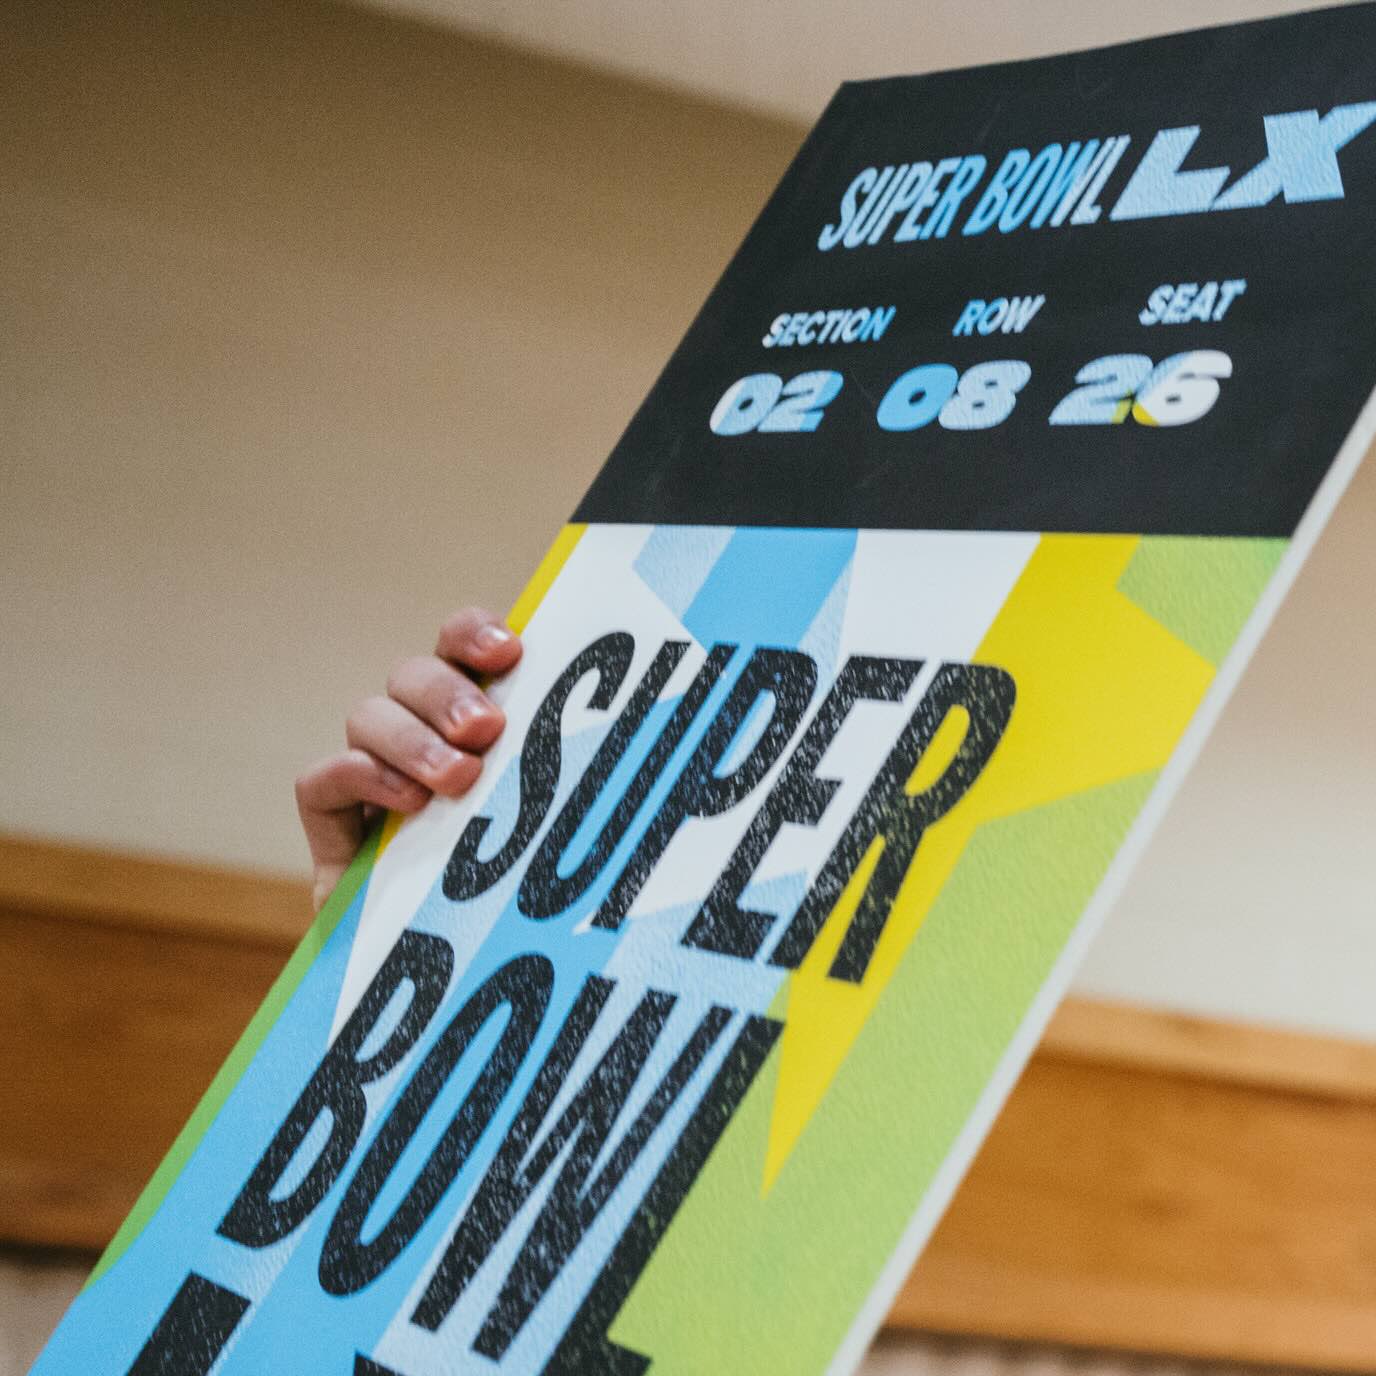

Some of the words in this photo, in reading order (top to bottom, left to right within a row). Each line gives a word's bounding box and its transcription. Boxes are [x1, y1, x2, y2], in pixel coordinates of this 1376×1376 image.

[817, 153, 986, 251] SUPER
[962, 134, 1131, 236] BOWL
[762, 306, 895, 348] SECTION
[952, 295, 1045, 337] ROW
[1138, 279, 1246, 326] SEAT
[709, 369, 844, 436] 02
[875, 360, 1032, 432] 08
[1048, 349, 1233, 427] 26
[441, 630, 1018, 985] SUPER
